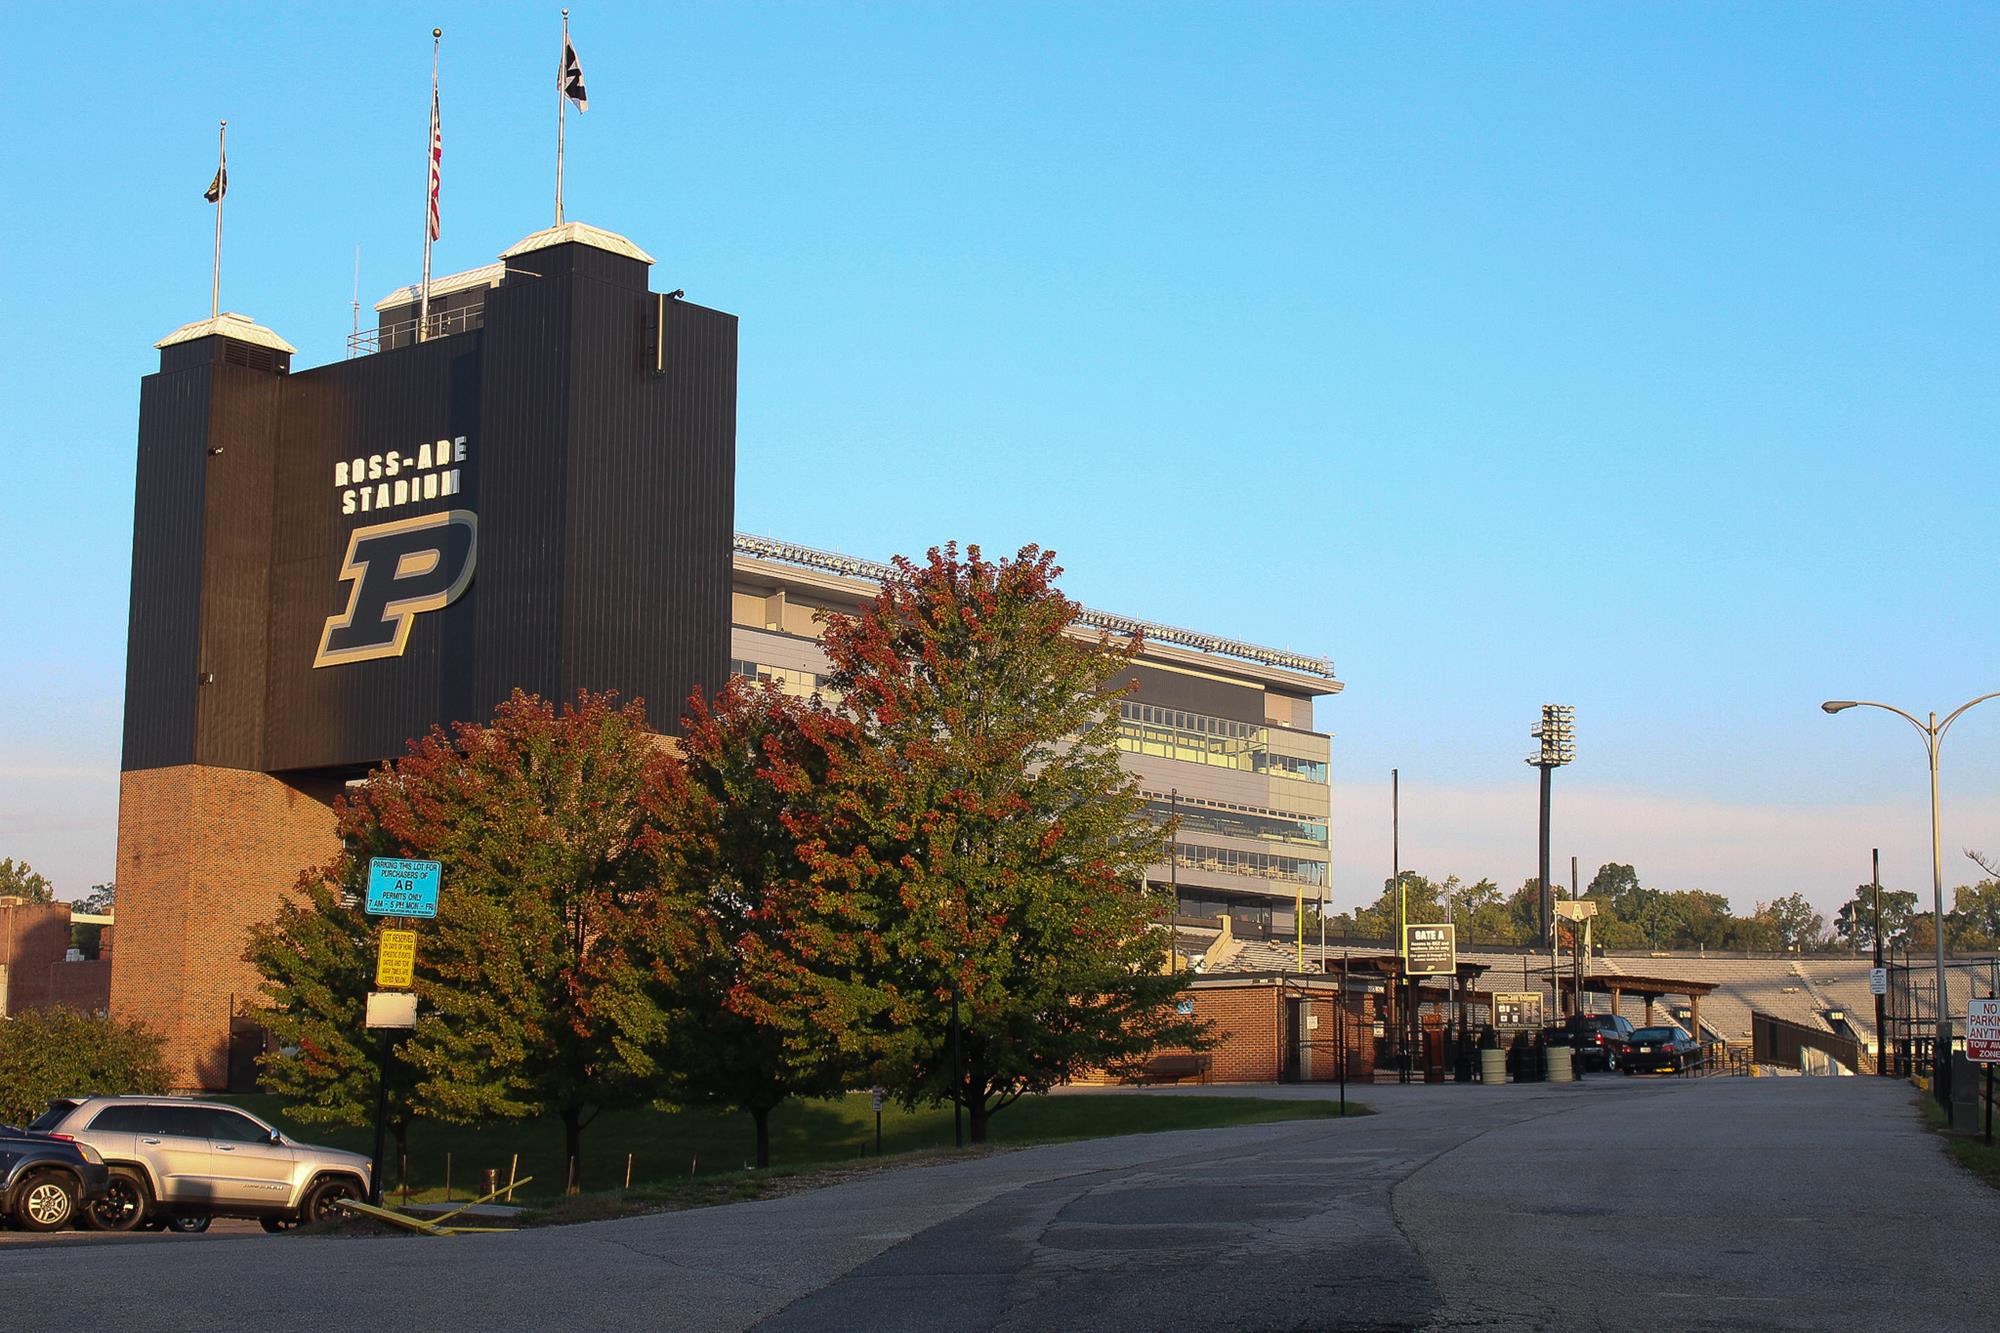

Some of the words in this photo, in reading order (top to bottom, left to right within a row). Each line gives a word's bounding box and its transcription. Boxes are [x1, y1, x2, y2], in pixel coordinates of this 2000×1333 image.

[335, 436, 467, 487] ROSS-ADE
[342, 469, 460, 515] STADIUM
[312, 509, 478, 668] P
[373, 860, 397, 869] PARKING
[381, 870, 418, 879] PURCHASERS
[382, 892, 406, 900] PERMITS
[392, 934, 413, 943] RESERVED
[1415, 930, 1436, 940] GATE
[1438, 930, 1444, 940] A
[1984, 1004, 1997, 1014] NO
